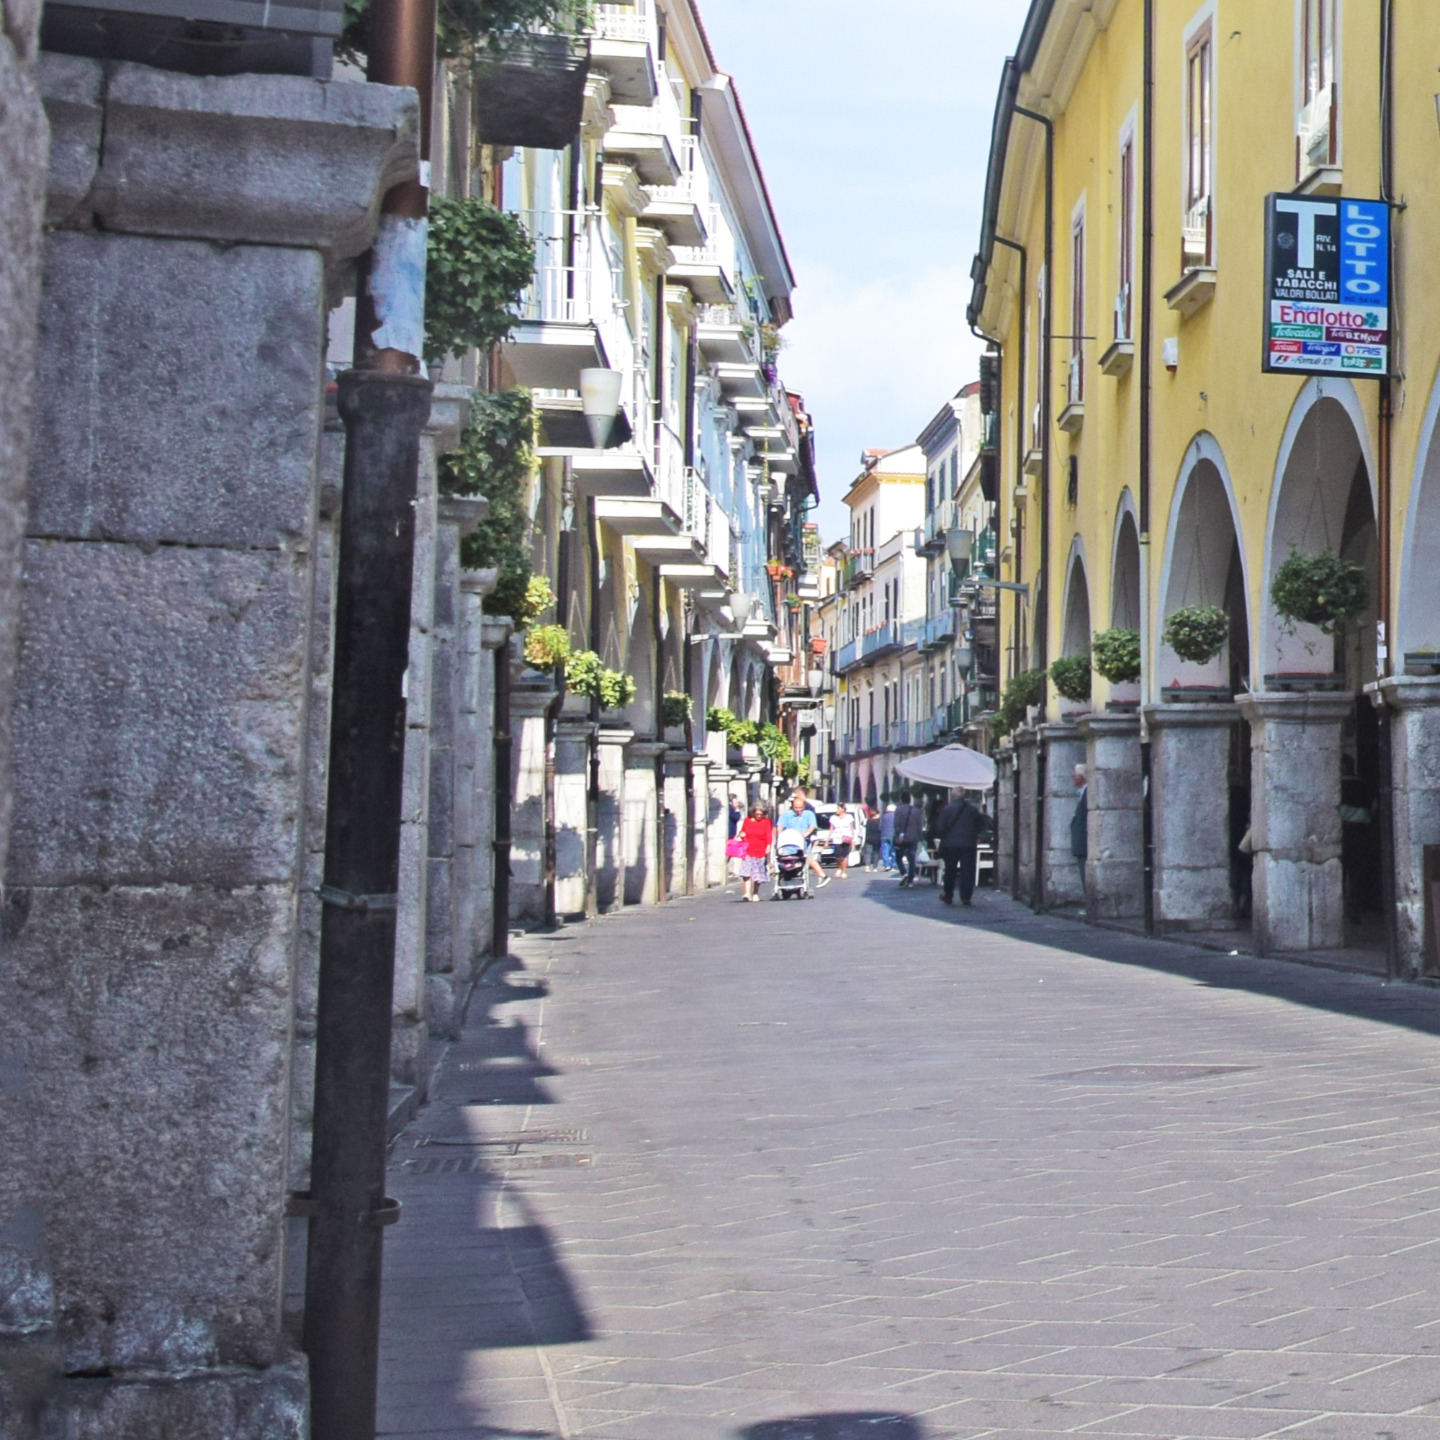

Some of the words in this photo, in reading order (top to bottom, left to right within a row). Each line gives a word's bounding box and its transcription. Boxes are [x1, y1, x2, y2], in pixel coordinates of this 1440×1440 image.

[1276, 199, 1338, 269] T
[1345, 204, 1381, 295] LOTTO
[1276, 278, 1337, 290] TABACCHI
[1287, 269, 1315, 280] SALI
[1318, 271, 1326, 281] E
[1275, 288, 1304, 299] VALORI
[1305, 290, 1338, 301] BOLLATI
[1280, 305, 1364, 328] Enalotto
